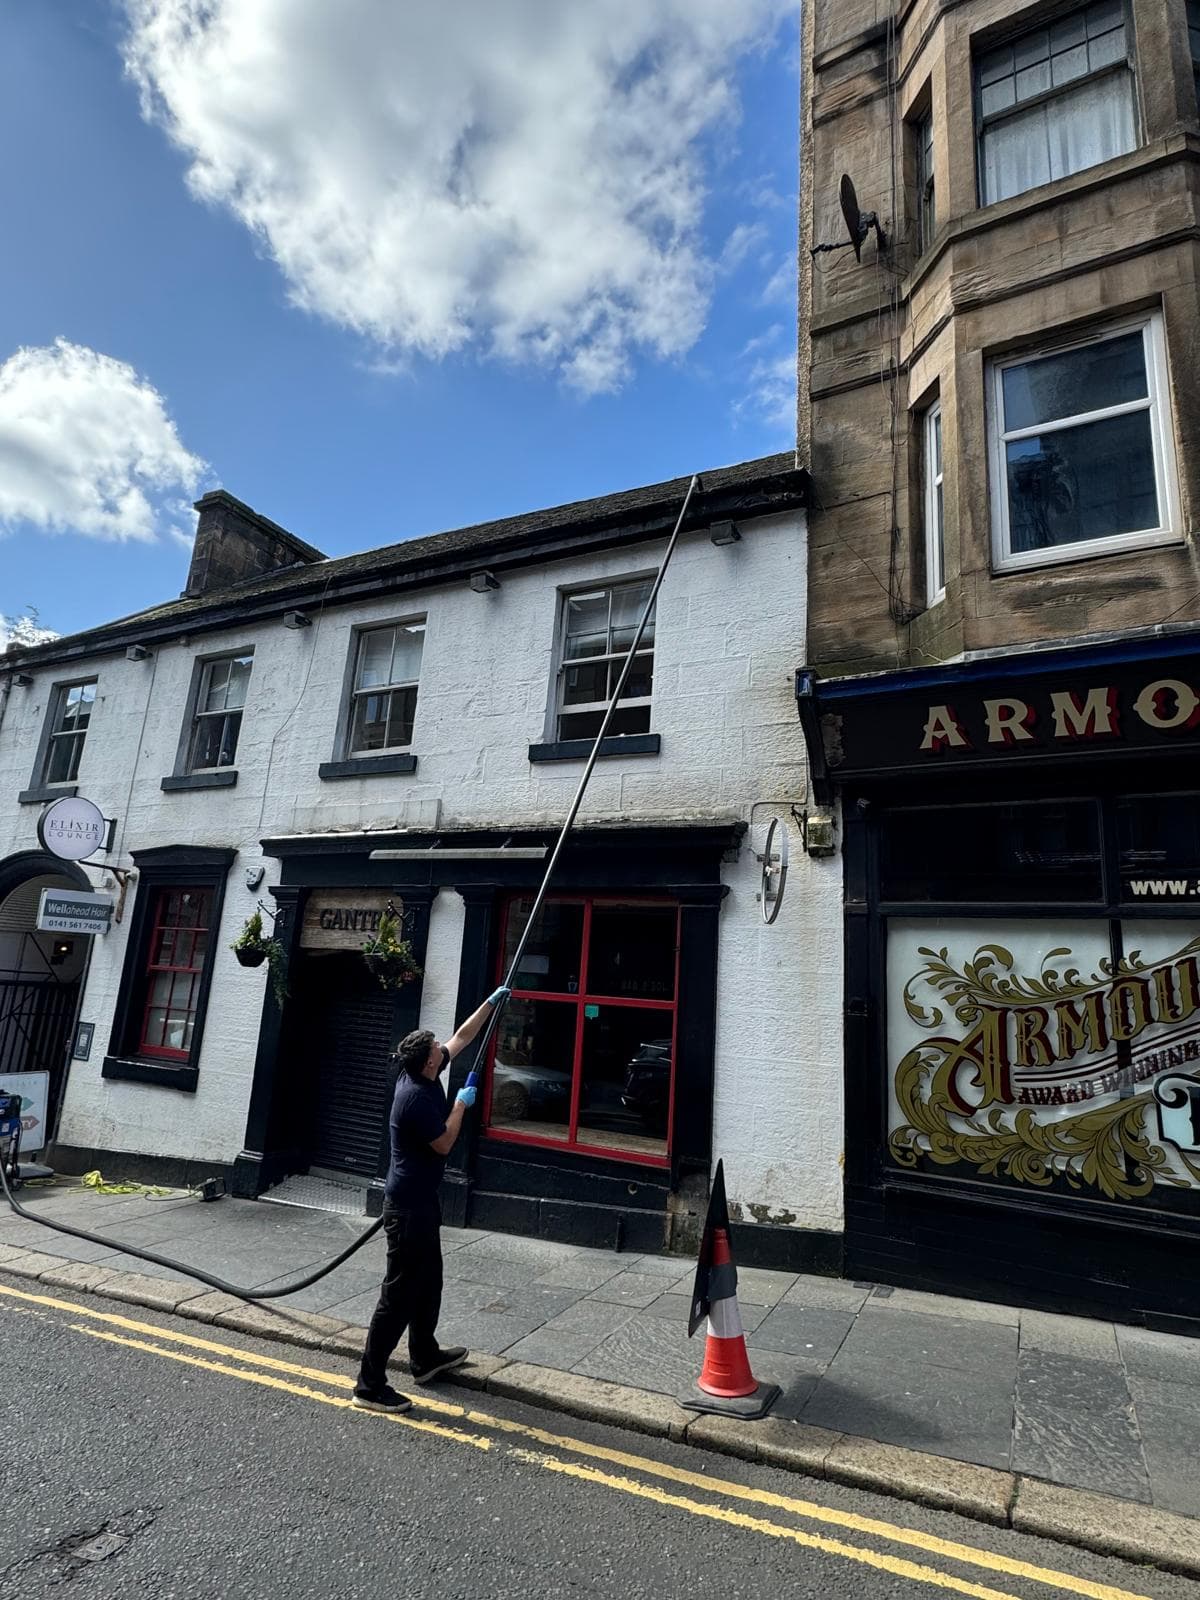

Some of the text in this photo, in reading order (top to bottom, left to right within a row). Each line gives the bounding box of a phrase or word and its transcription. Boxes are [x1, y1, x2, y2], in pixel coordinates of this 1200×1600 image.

[50, 819, 99, 832] ELIXIR
[48, 831, 100, 840] LOUNGE
[48, 903, 108, 918] Wellahead Hair
[48, 919, 67, 927] 0141
[1017, 1080, 1095, 1105] AWARD
